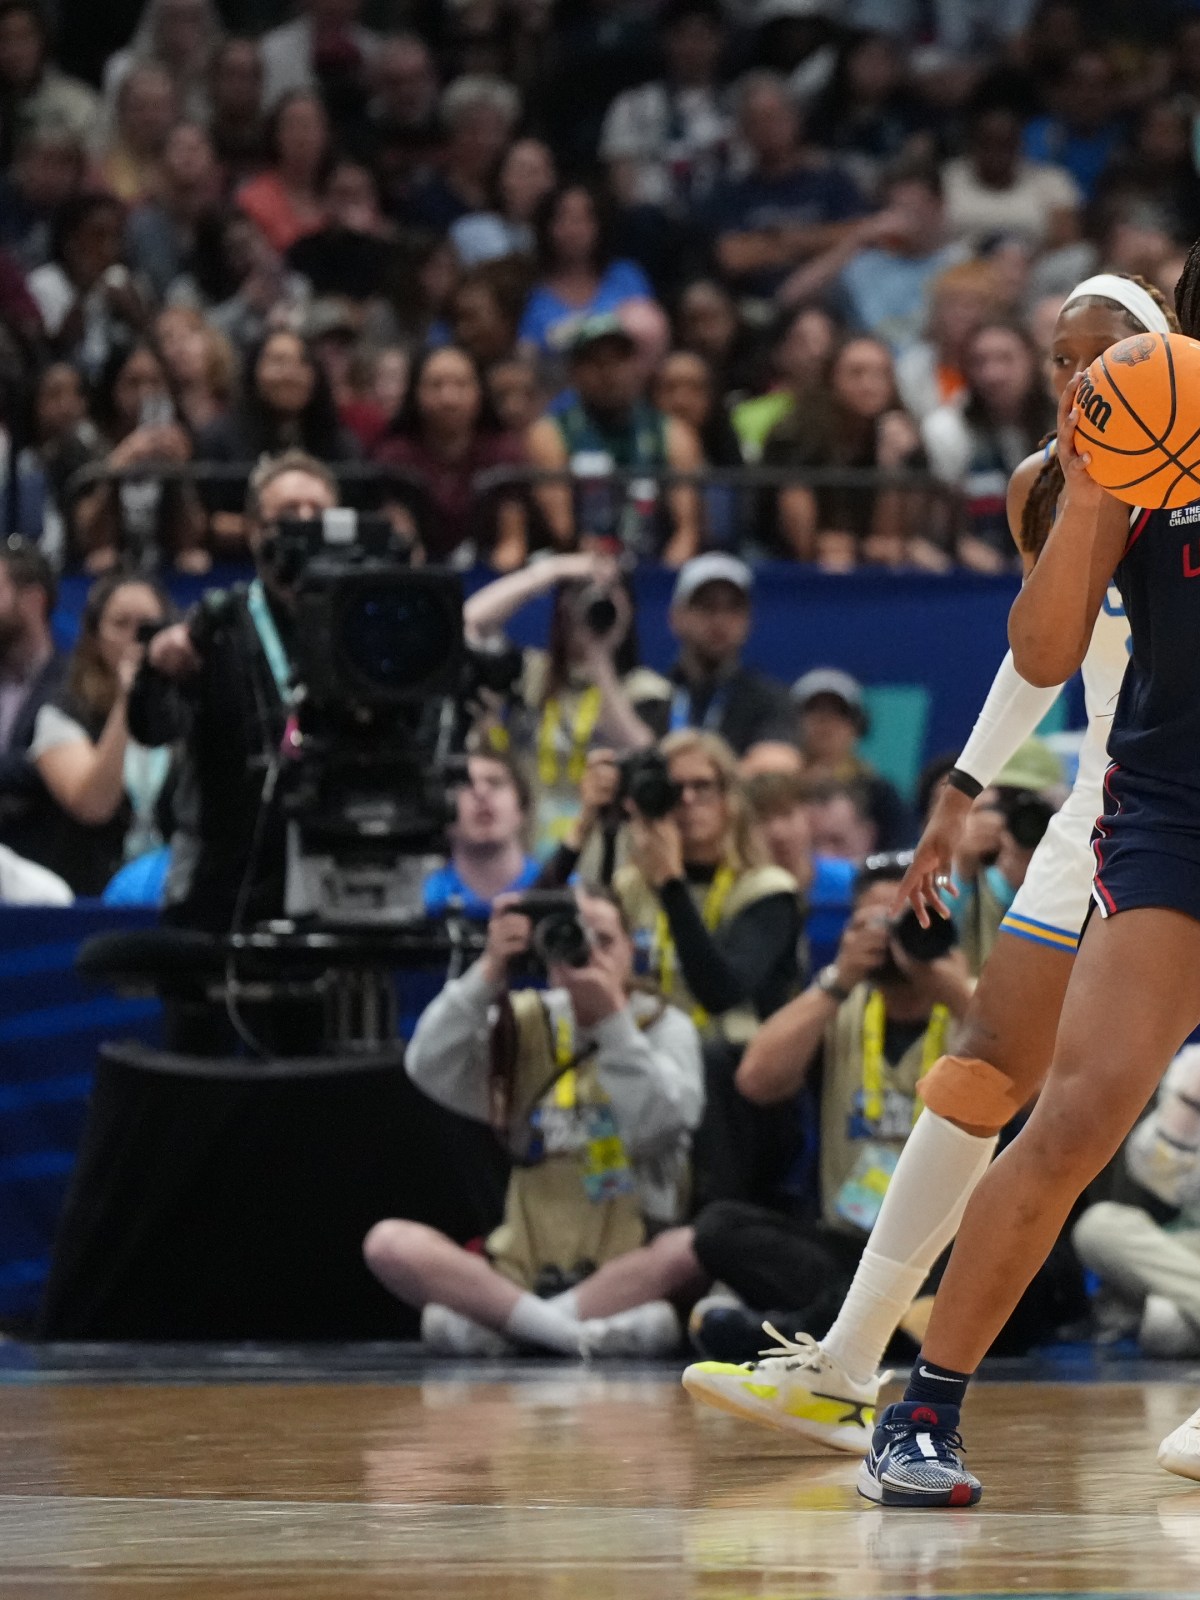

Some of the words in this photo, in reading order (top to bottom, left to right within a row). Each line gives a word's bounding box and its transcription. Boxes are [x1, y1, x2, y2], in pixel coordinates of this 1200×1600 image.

[1076, 376, 1112, 434] Wil
[1171, 509, 1183, 519] BE
[1184, 505, 1200, 516] THE
